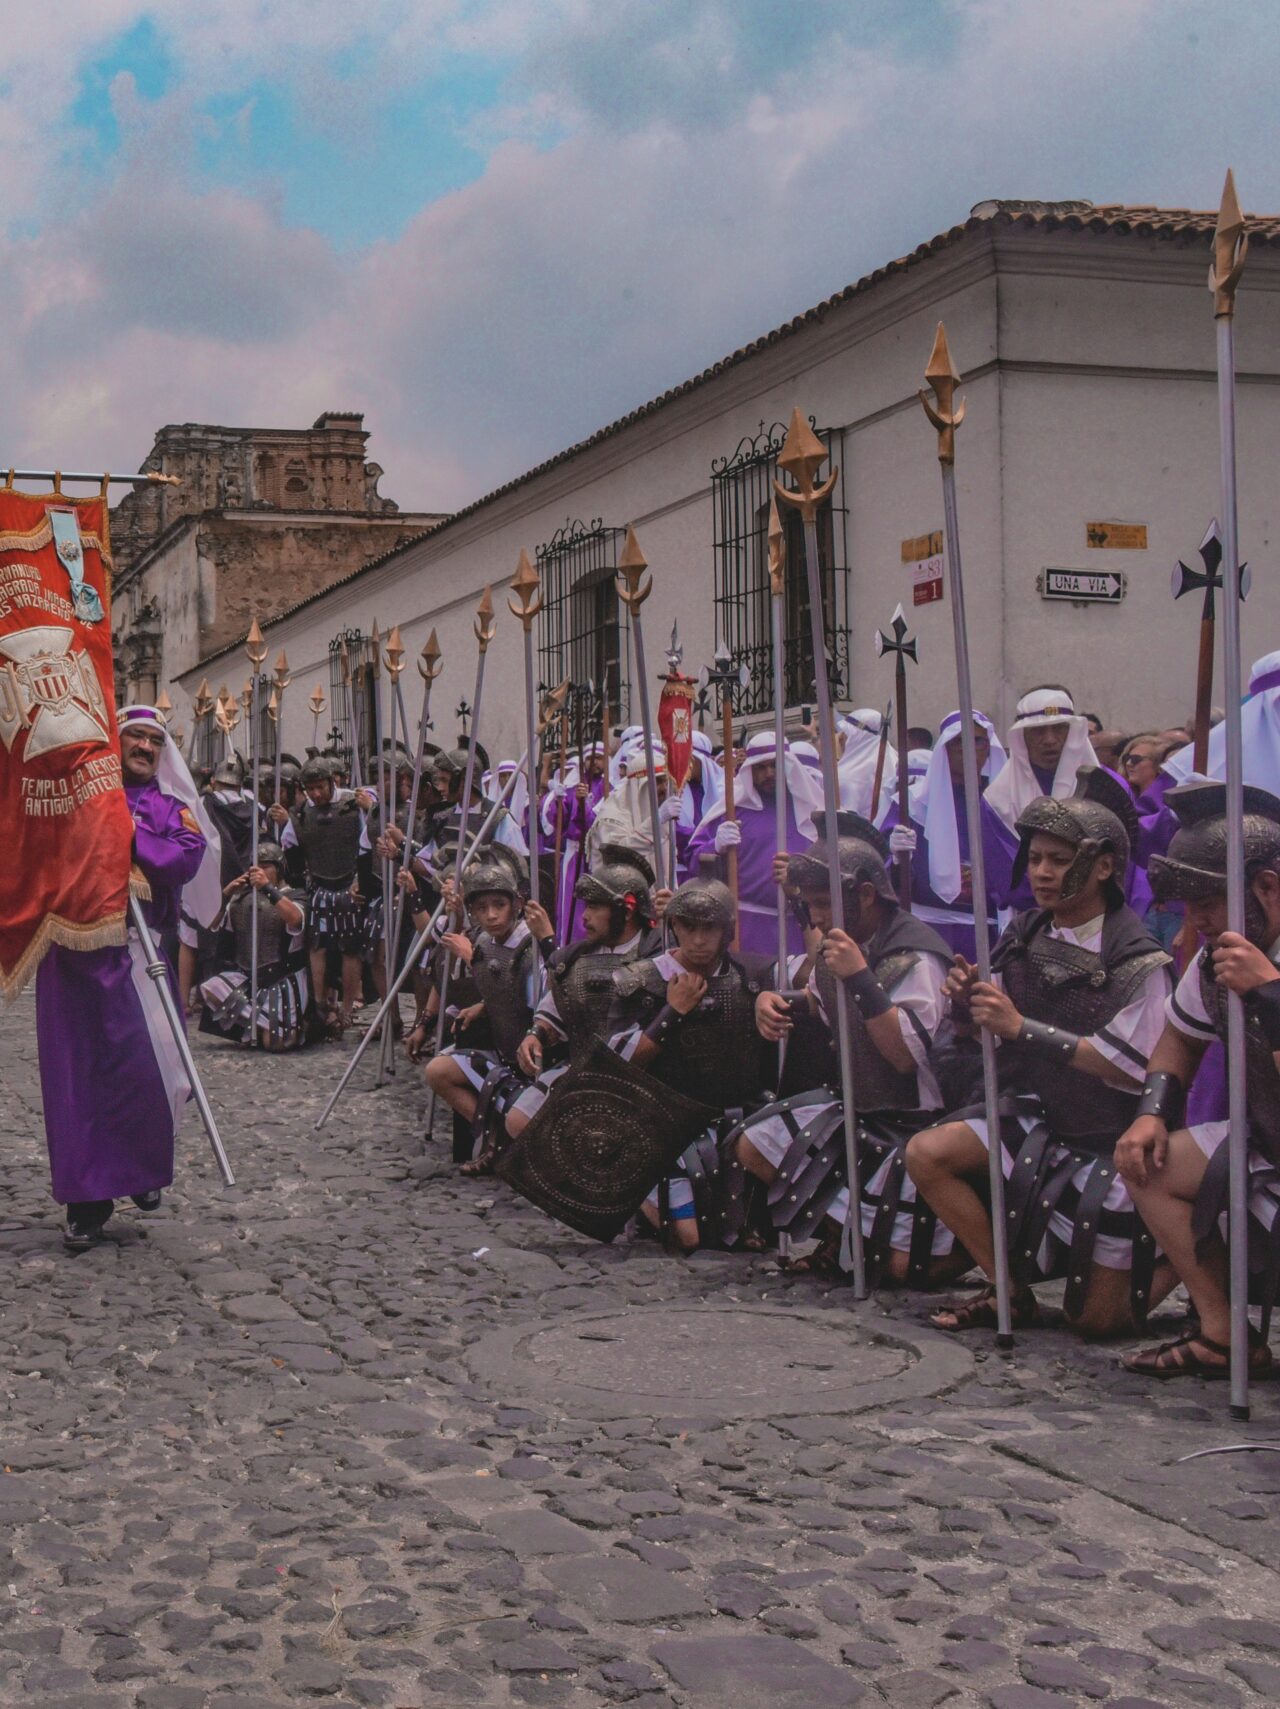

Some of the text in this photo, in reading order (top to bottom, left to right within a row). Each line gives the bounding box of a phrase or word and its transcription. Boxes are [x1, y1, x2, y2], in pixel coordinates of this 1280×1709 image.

[1055, 575, 1108, 592] UNA VIA
[13, 594, 71, 622] NAZARENO
[21, 777, 68, 798] TEMPLO
[71, 769, 85, 790] LA
[25, 795, 76, 817] ANTIGUA
